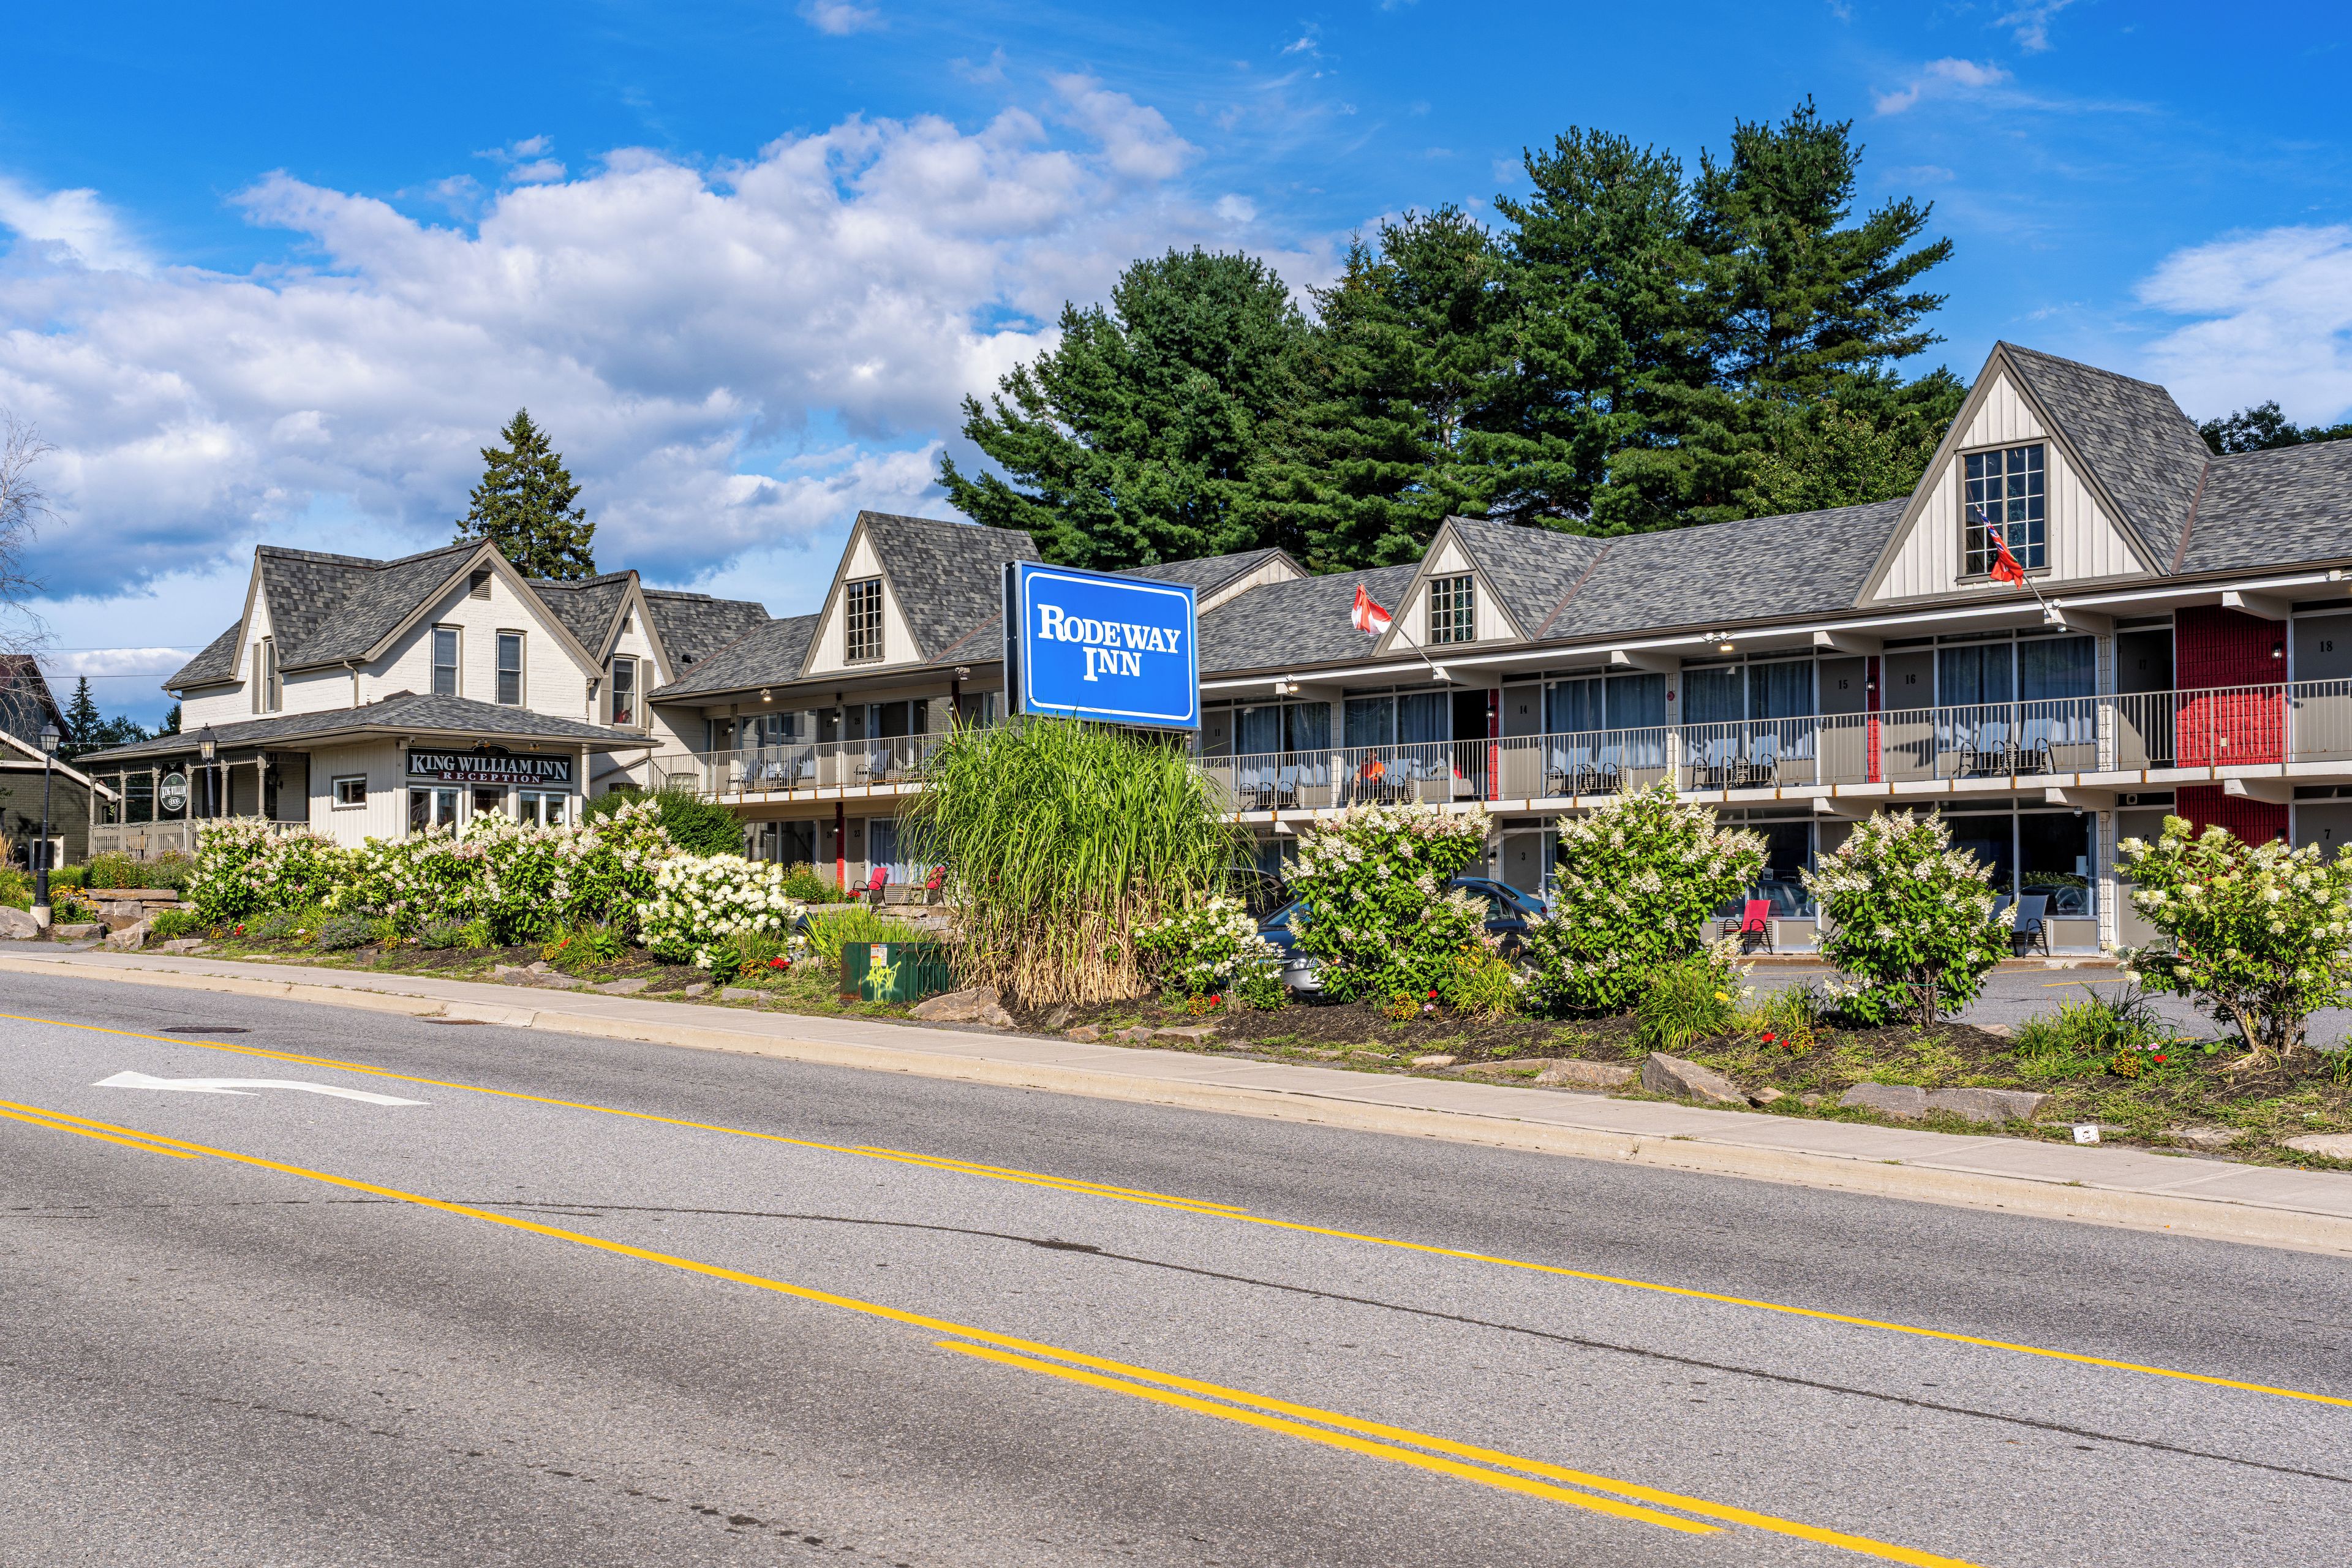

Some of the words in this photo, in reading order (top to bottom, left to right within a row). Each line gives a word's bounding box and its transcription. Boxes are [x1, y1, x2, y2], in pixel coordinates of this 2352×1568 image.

[1038, 604, 1181, 654] RODEWAY
[2321, 641, 2332, 652] 18
[1083, 646, 1142, 682] INN
[2139, 659, 2146, 670] 17
[1839, 680, 1848, 689] 15
[1906, 674, 1915, 684] 16
[410, 754, 455, 773] KING
[458, 756, 533, 774] WILLIAM
[536, 760, 569, 780] INN
[443, 772, 541, 783] RECEPTION
[2144, 834, 2149, 845] 6
[2325, 829, 2331, 839] 7
[1521, 852, 1526, 861] 3
